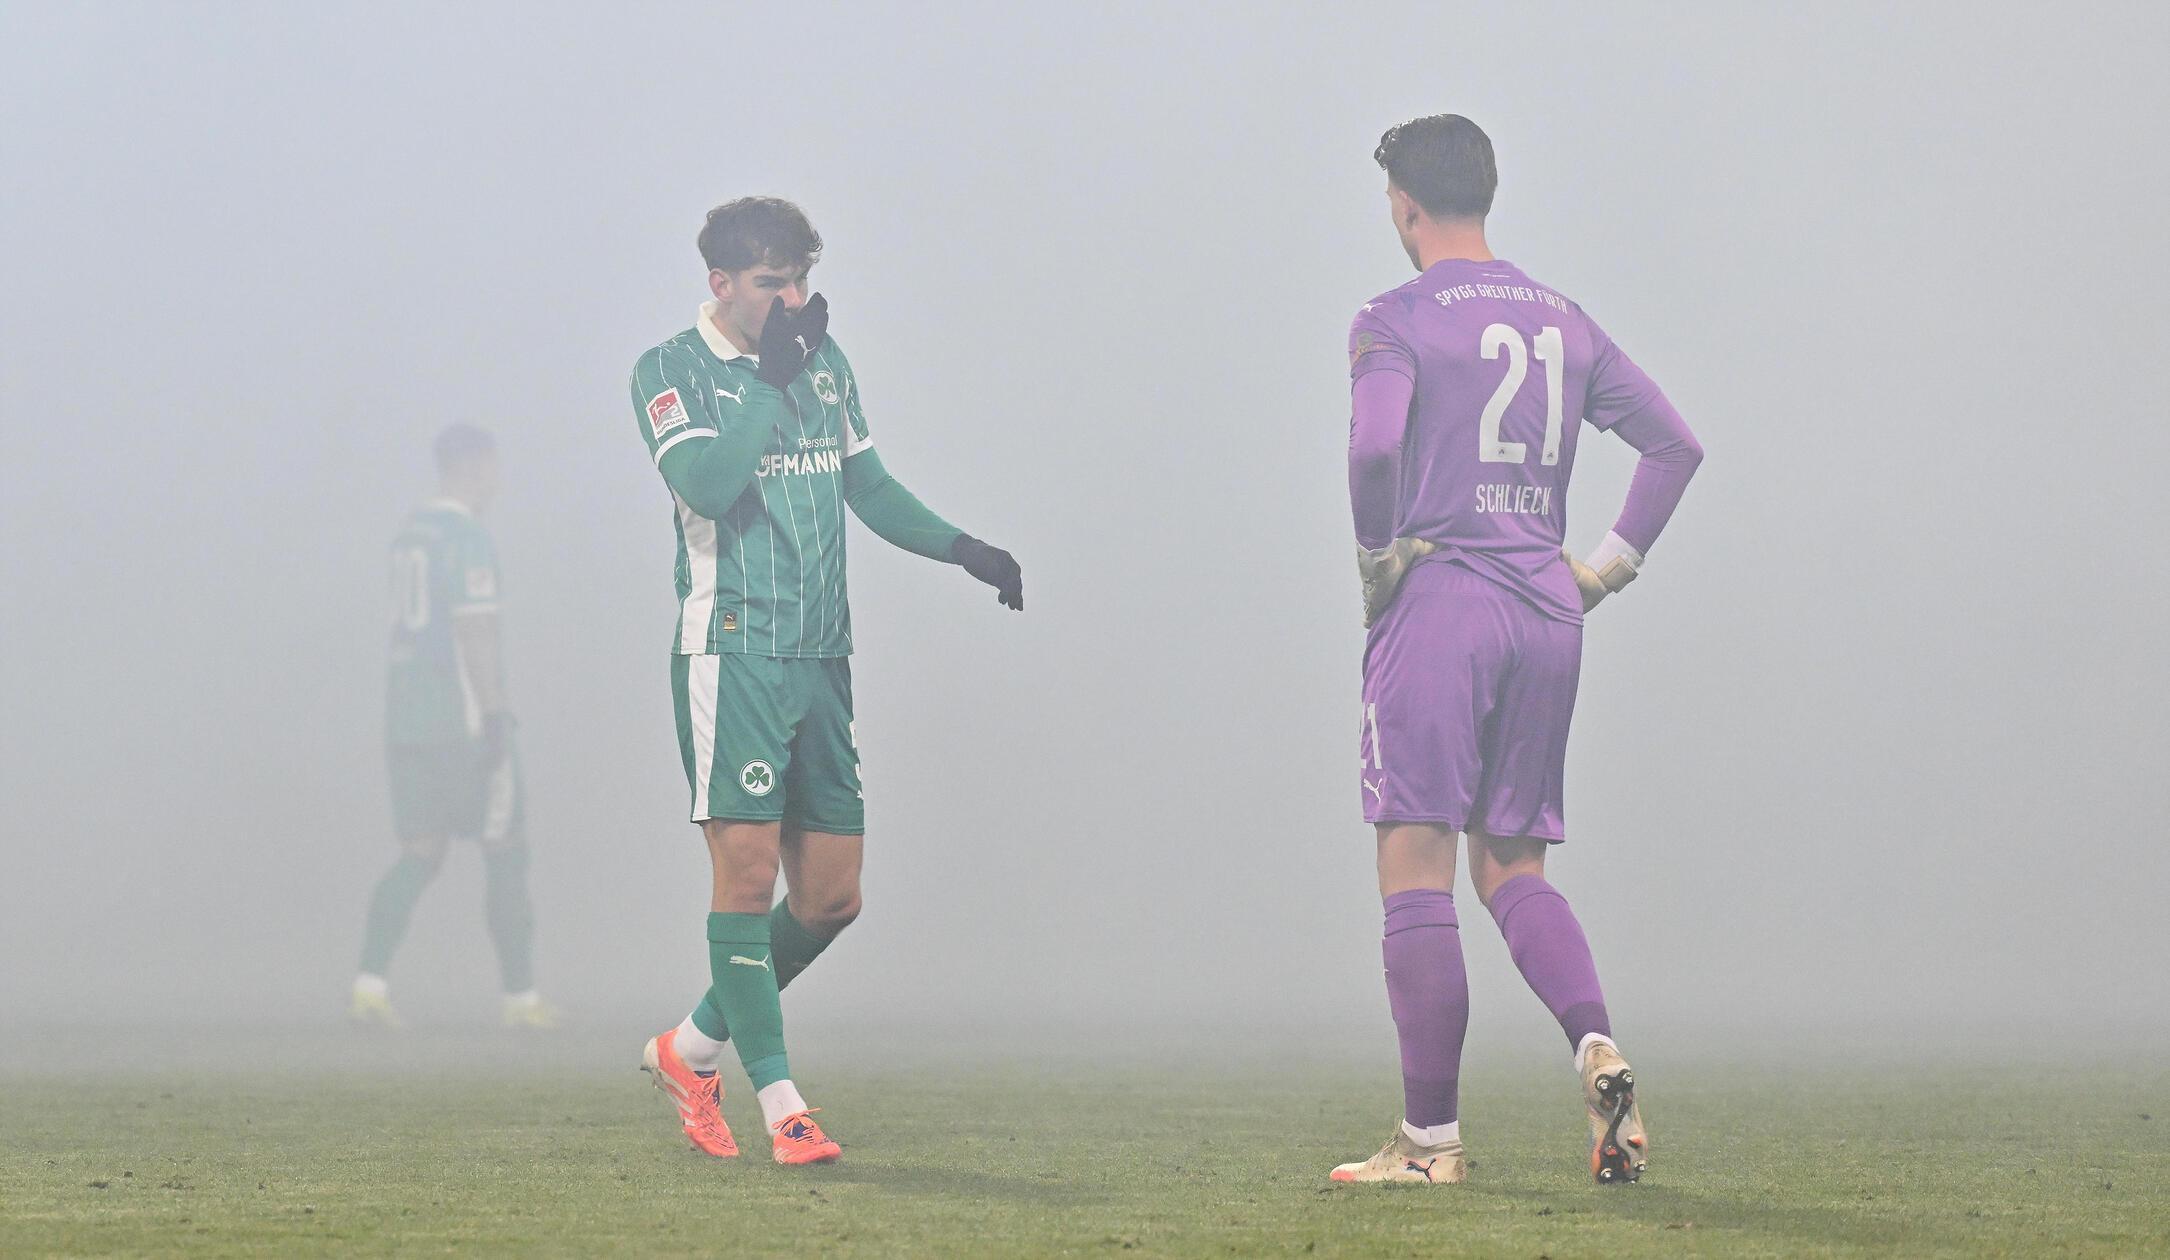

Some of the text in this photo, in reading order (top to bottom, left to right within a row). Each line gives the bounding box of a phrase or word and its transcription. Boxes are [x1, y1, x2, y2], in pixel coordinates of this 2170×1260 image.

[1435, 284, 1477, 306] SPVGG
[1476, 284, 1535, 302] GREUTHER
[1480, 323, 1563, 466] 21
[799, 435, 838, 449] Personal
[1475, 484, 1552, 515] SCHLIECK
